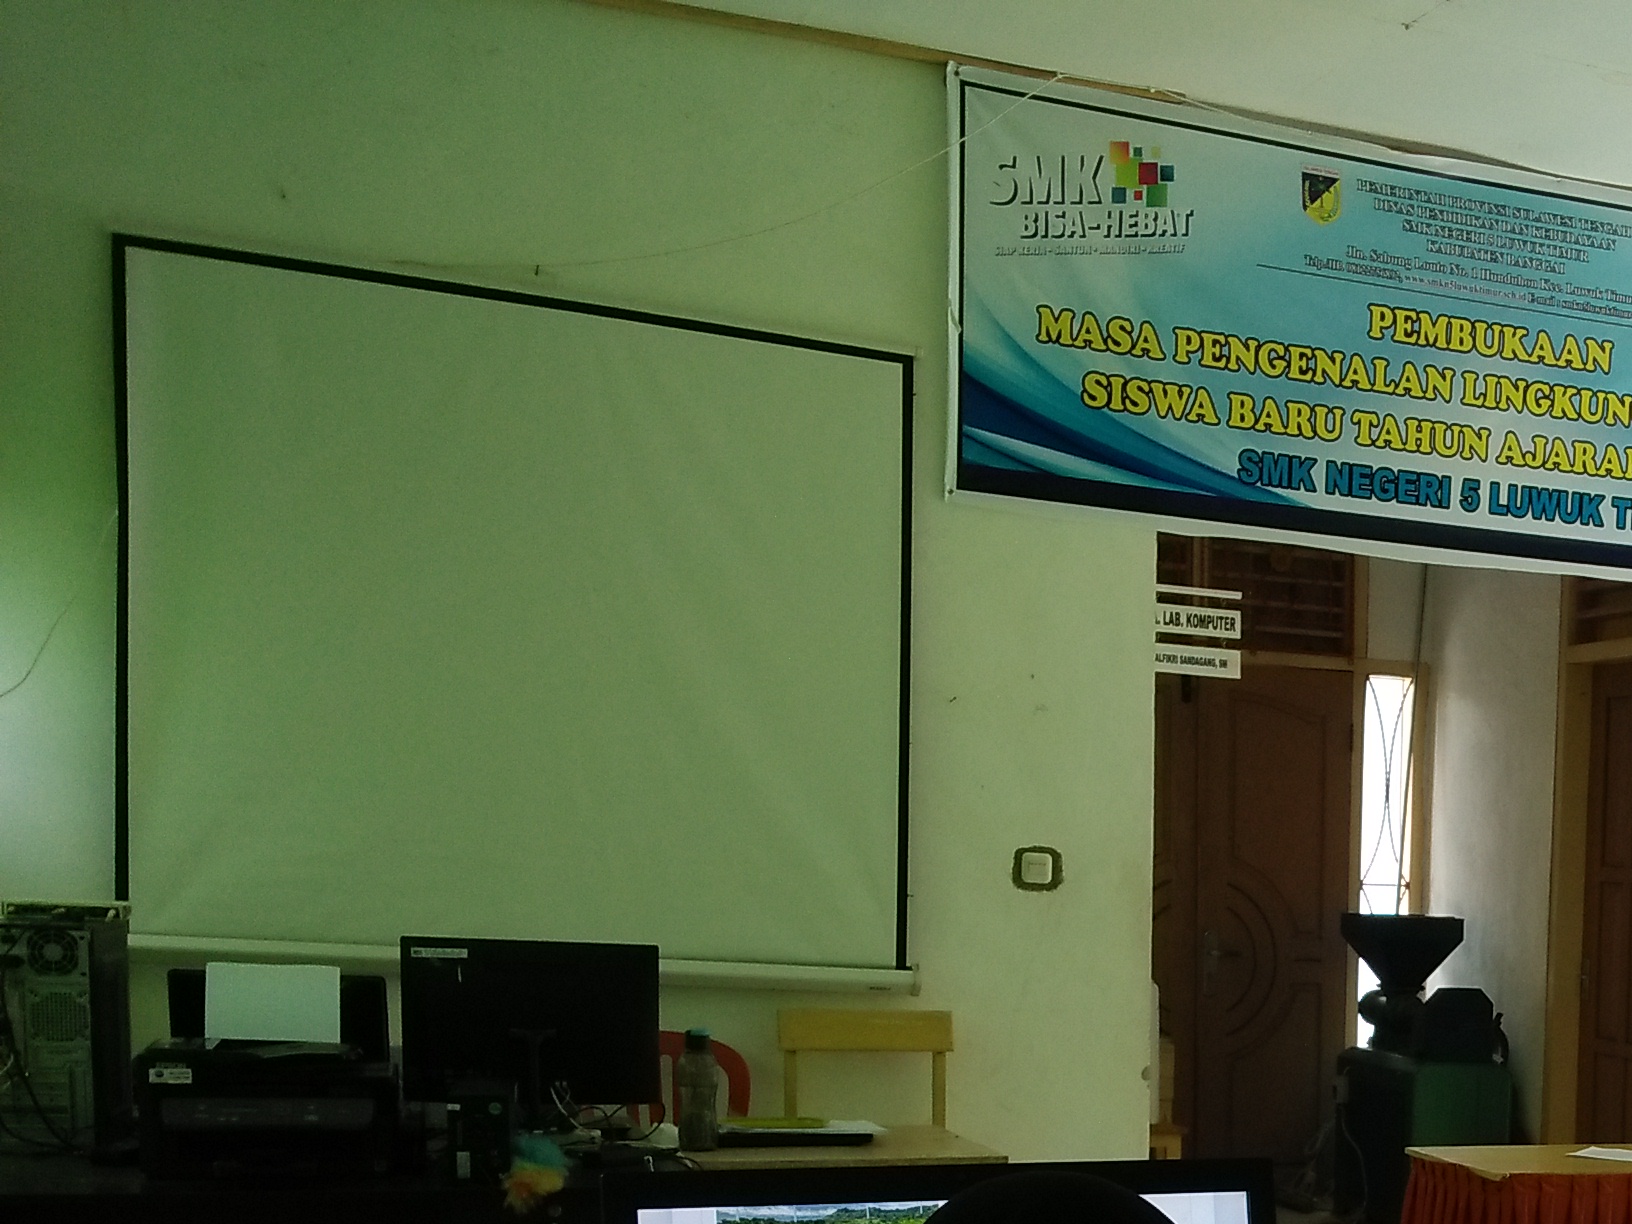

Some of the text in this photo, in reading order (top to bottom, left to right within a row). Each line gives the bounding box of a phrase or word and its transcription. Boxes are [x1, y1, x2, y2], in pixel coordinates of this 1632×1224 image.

[990, 154, 1105, 206] SMK
[1357, 179, 1632, 238] PEMERINTAH PROVINSI SULAWESI TENGAH
[1374, 198, 1616, 251] DINAS PENDIDIKAN DAN KEBUDAYAAN
[1403, 219, 1431, 235] SMK
[1434, 224, 1485, 244] NEGERI
[1497, 235, 1545, 255] LUWUK
[1548, 245, 1589, 263] TIMUR
[1426, 239, 1566, 275] KABUPATEN BANGGAI
[1449, 262, 1468, 278] No.
[1540, 278, 1563, 294] Kec.
[1566, 282, 1603, 300] Luwuk
[1036, 304, 1166, 361] MASA
[1172, 326, 1457, 403] PENGENALAN
[1367, 303, 1615, 375] PEMBUKAAN
[1082, 371, 1221, 426] SISWA
[1228, 392, 1345, 443] BARU
[1351, 411, 1492, 462] TAHUN
[1237, 448, 1318, 492] SMK
[1325, 460, 1451, 510] NEGERI
[1459, 476, 1481, 512] 5
[1488, 480, 1605, 528] LUWUK
[1163, 611, 1184, 628] LAB.
[1186, 612, 1236, 633] KOMPUTER
